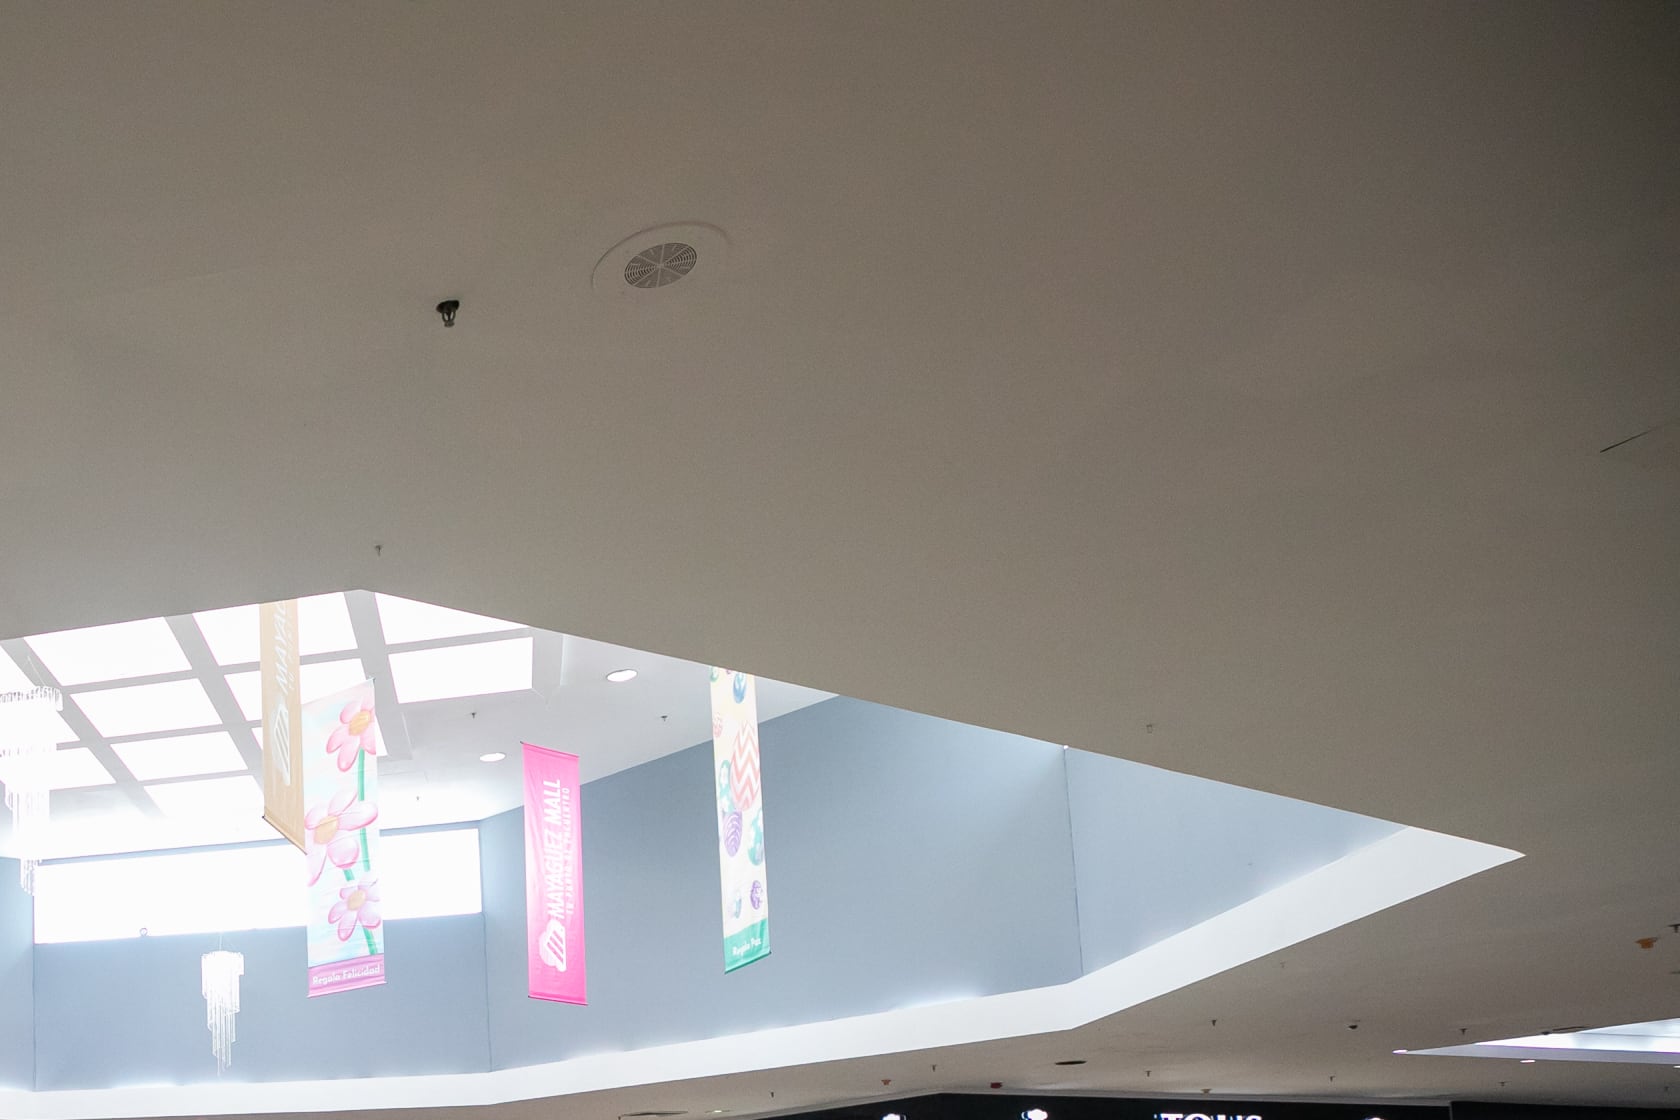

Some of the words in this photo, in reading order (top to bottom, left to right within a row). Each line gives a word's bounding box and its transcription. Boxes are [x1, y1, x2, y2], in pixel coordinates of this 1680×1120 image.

[543, 779, 562, 826] MALL
[312, 971, 340, 985] Regala
[342, 963, 380, 979] Felicidad
